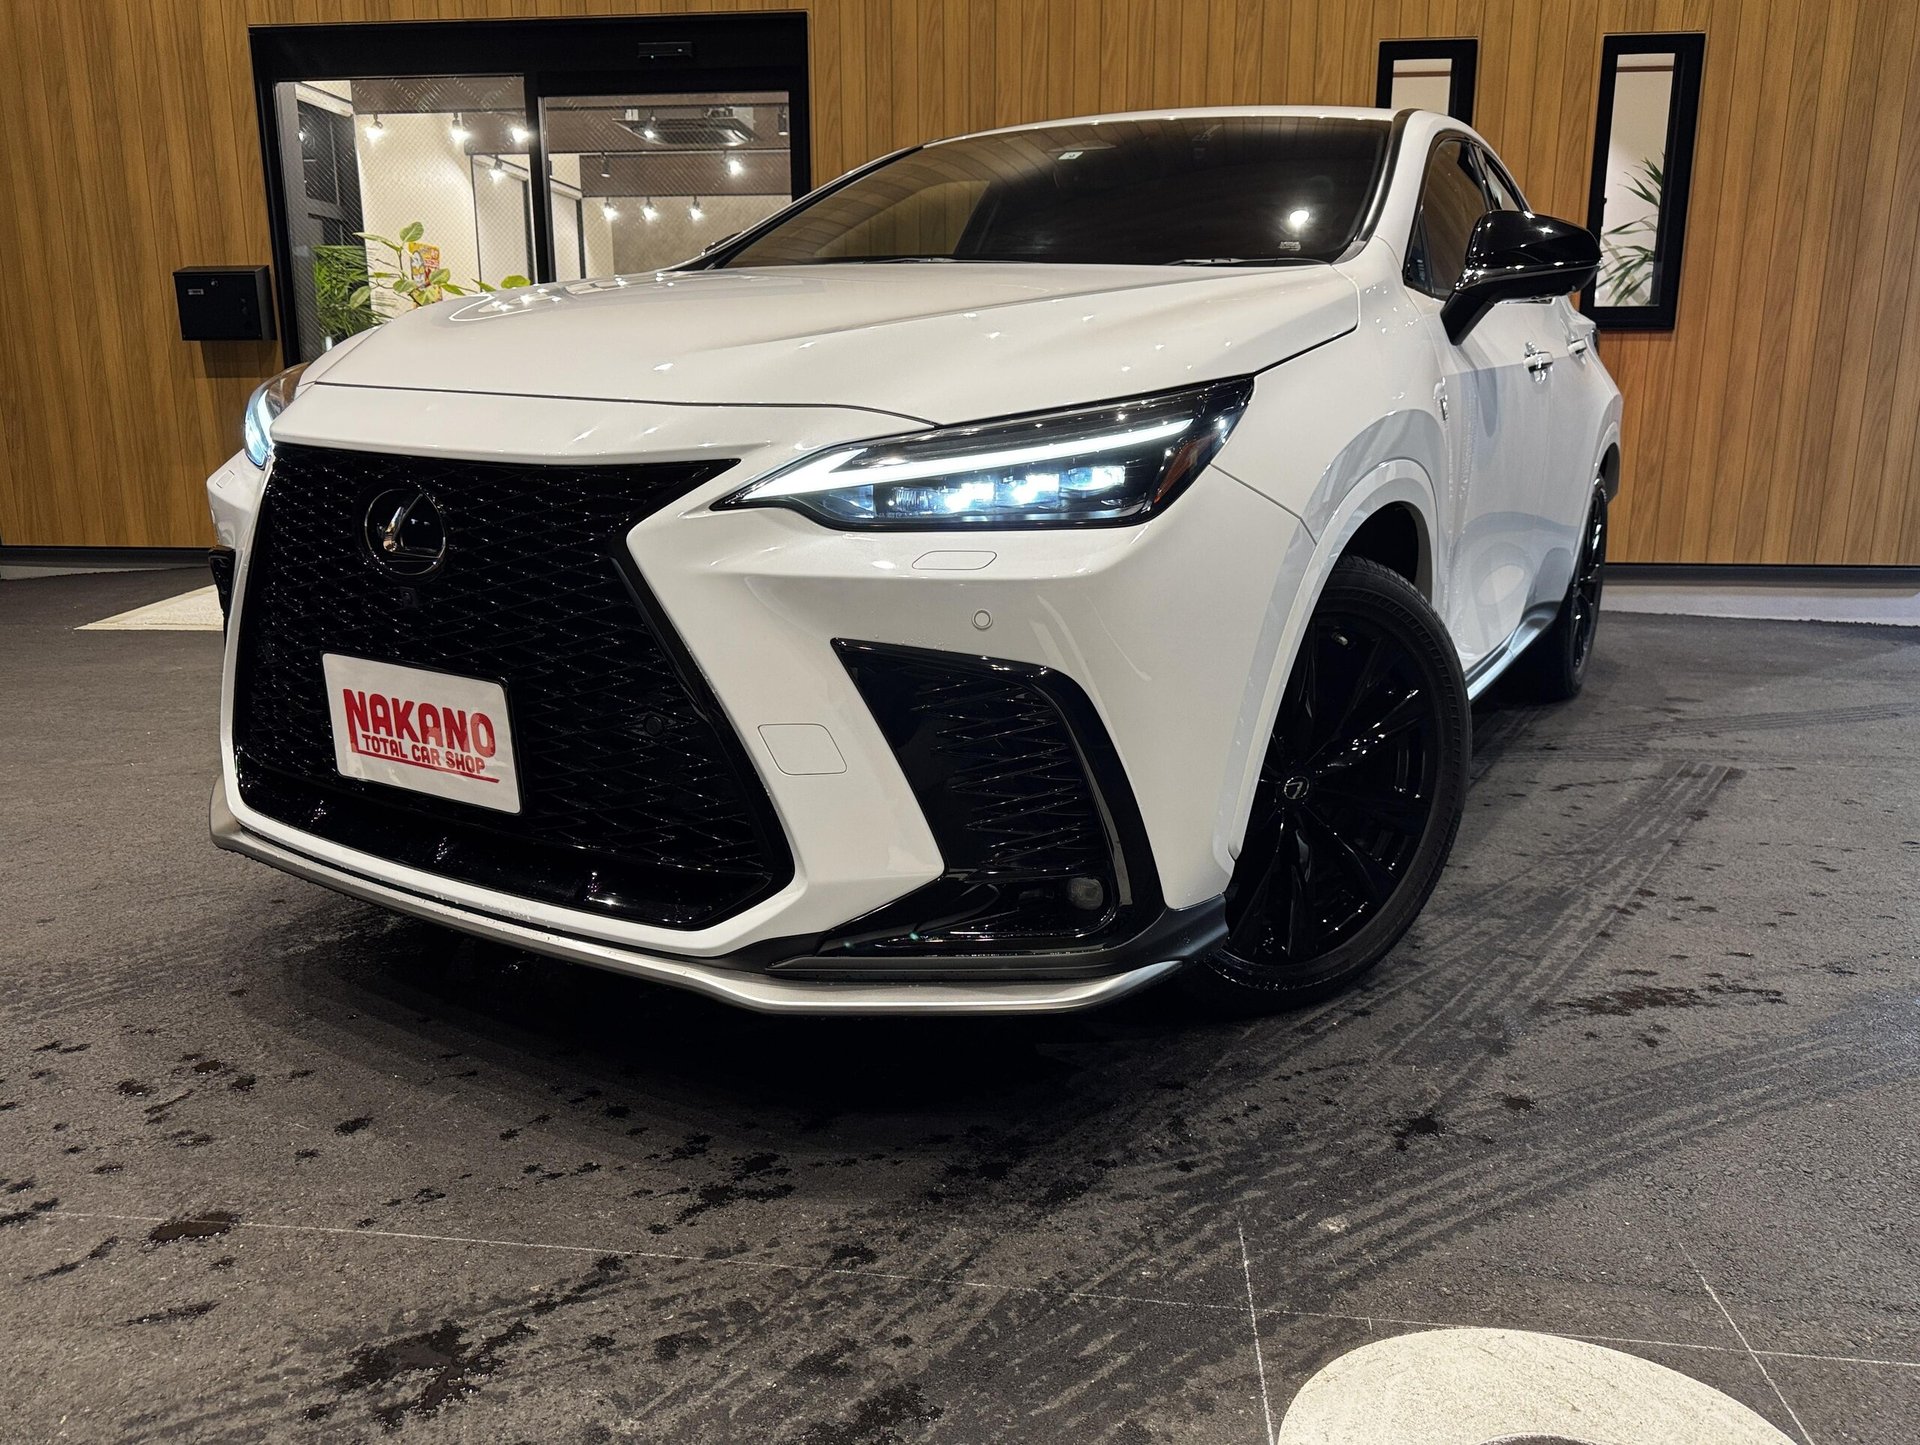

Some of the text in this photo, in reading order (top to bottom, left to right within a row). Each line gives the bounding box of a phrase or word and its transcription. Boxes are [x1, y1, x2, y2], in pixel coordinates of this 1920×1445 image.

[343, 689, 496, 758] NAKANO
[362, 734, 486, 774] TOTAL CAR SHOP
